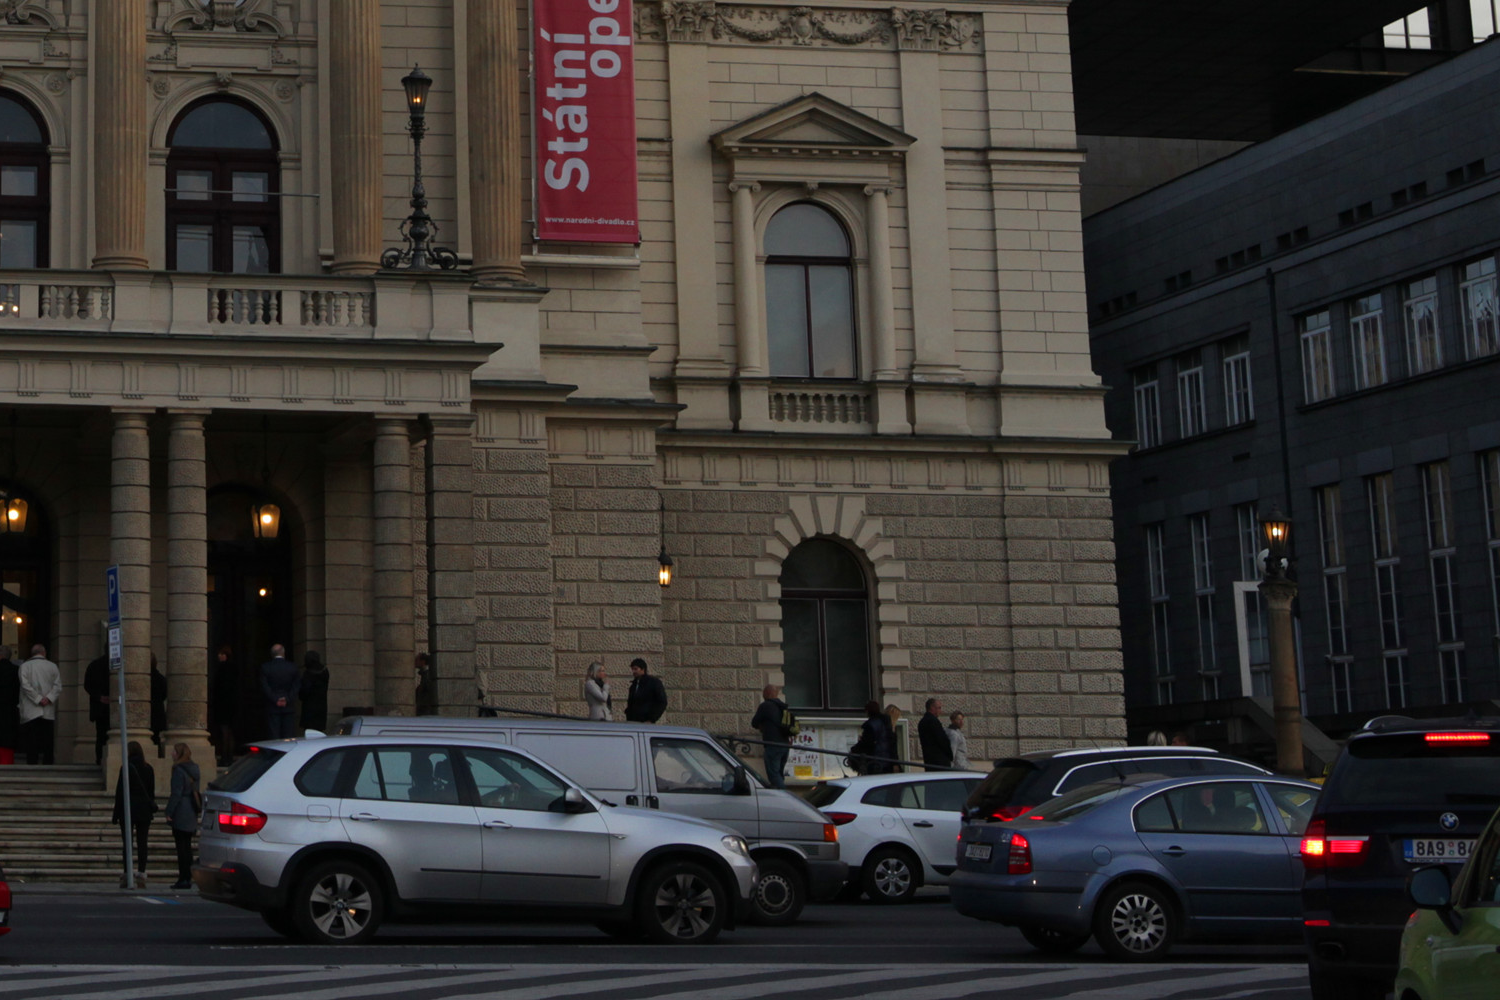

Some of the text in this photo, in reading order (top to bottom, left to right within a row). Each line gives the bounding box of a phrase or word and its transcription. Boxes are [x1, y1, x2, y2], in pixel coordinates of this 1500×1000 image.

[540, 27, 590, 193] Státní
[544, 216, 636, 226] www.narodni-divadlo.cz
[1416, 841, 1445, 856] 8A9
